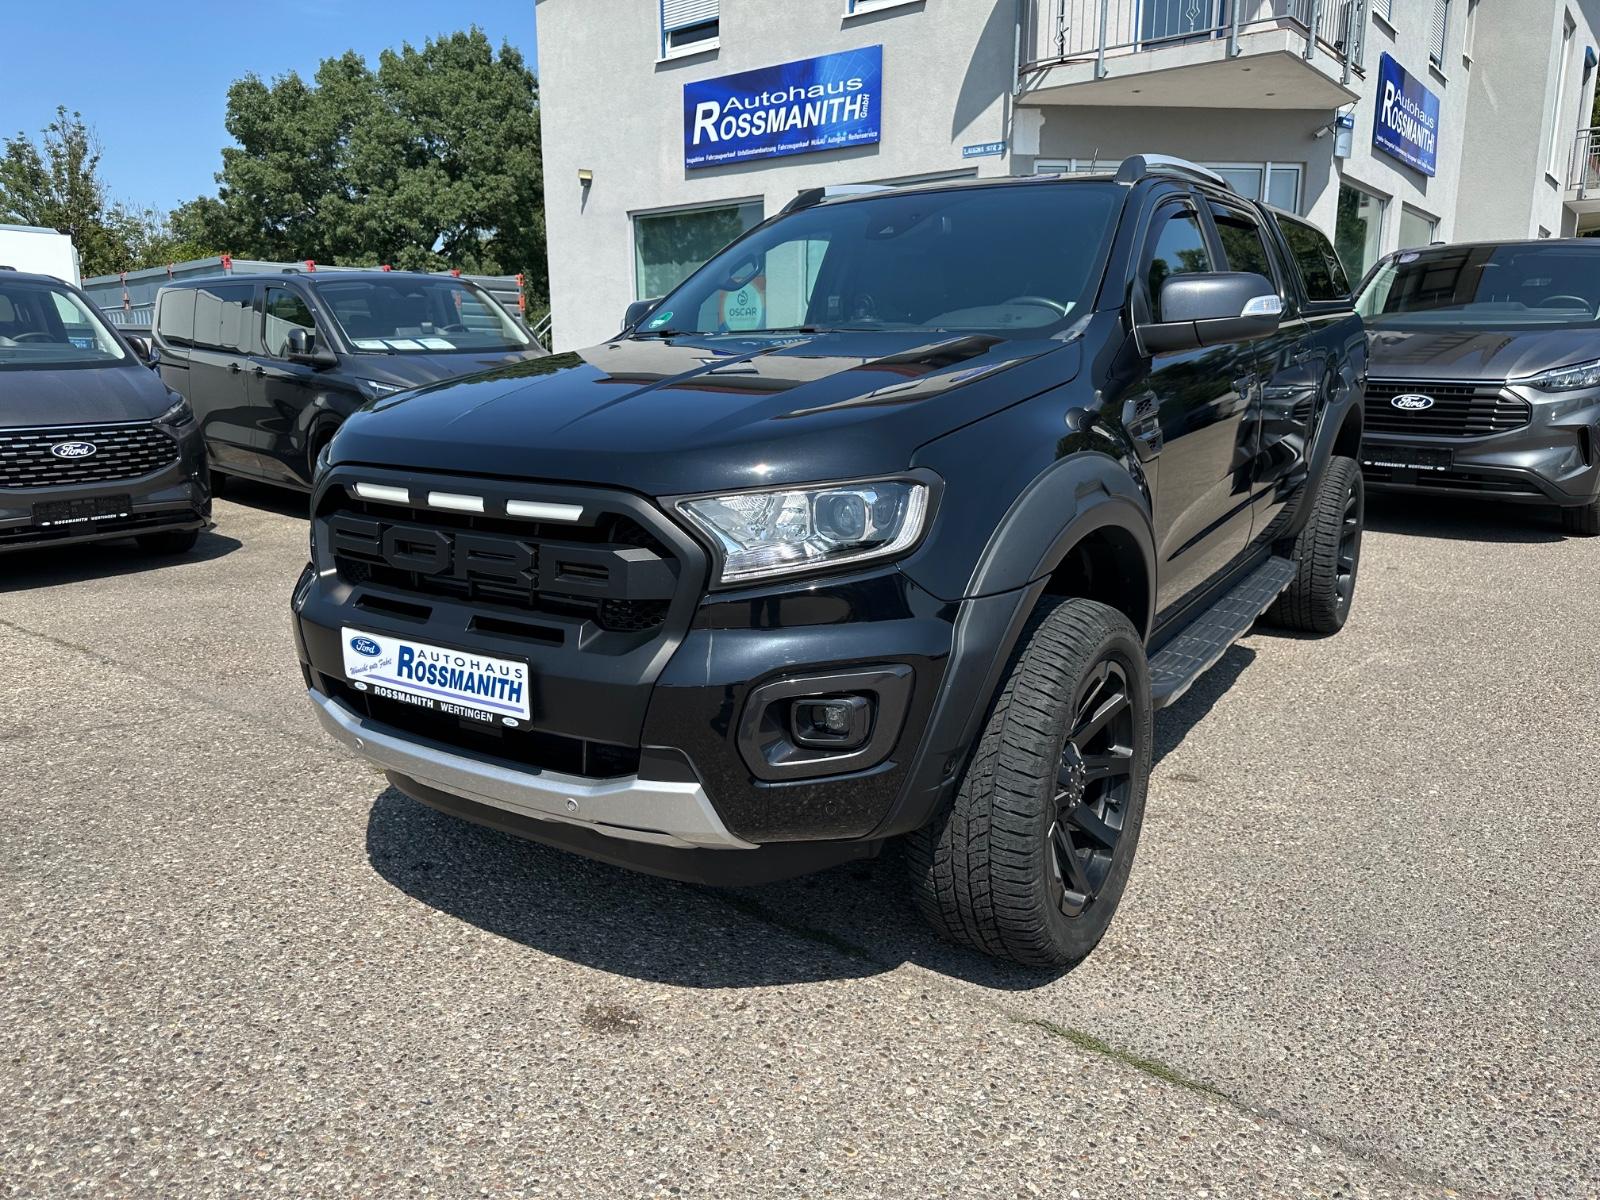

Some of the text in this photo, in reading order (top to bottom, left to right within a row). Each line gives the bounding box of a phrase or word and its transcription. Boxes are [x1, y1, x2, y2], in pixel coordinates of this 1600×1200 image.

[722, 77, 863, 113] Autohaus
[860, 93, 870, 118] GmbH
[1394, 88, 1435, 129] Autohaus
[692, 93, 863, 145] ROSSMANITH
[1381, 79, 1434, 154] ROSSMANITH
[729, 306, 758, 317] OSCAR
[1397, 395, 1428, 407] Ford
[60, 443, 89, 456] Ford
[328, 513, 660, 600] FORD
[396, 645, 523, 704] ROSSMANITH
[417, 649, 523, 680] AUTOHAUS
[374, 685, 434, 709] ROSSMANITH
[440, 702, 494, 723] WERTINGEN
